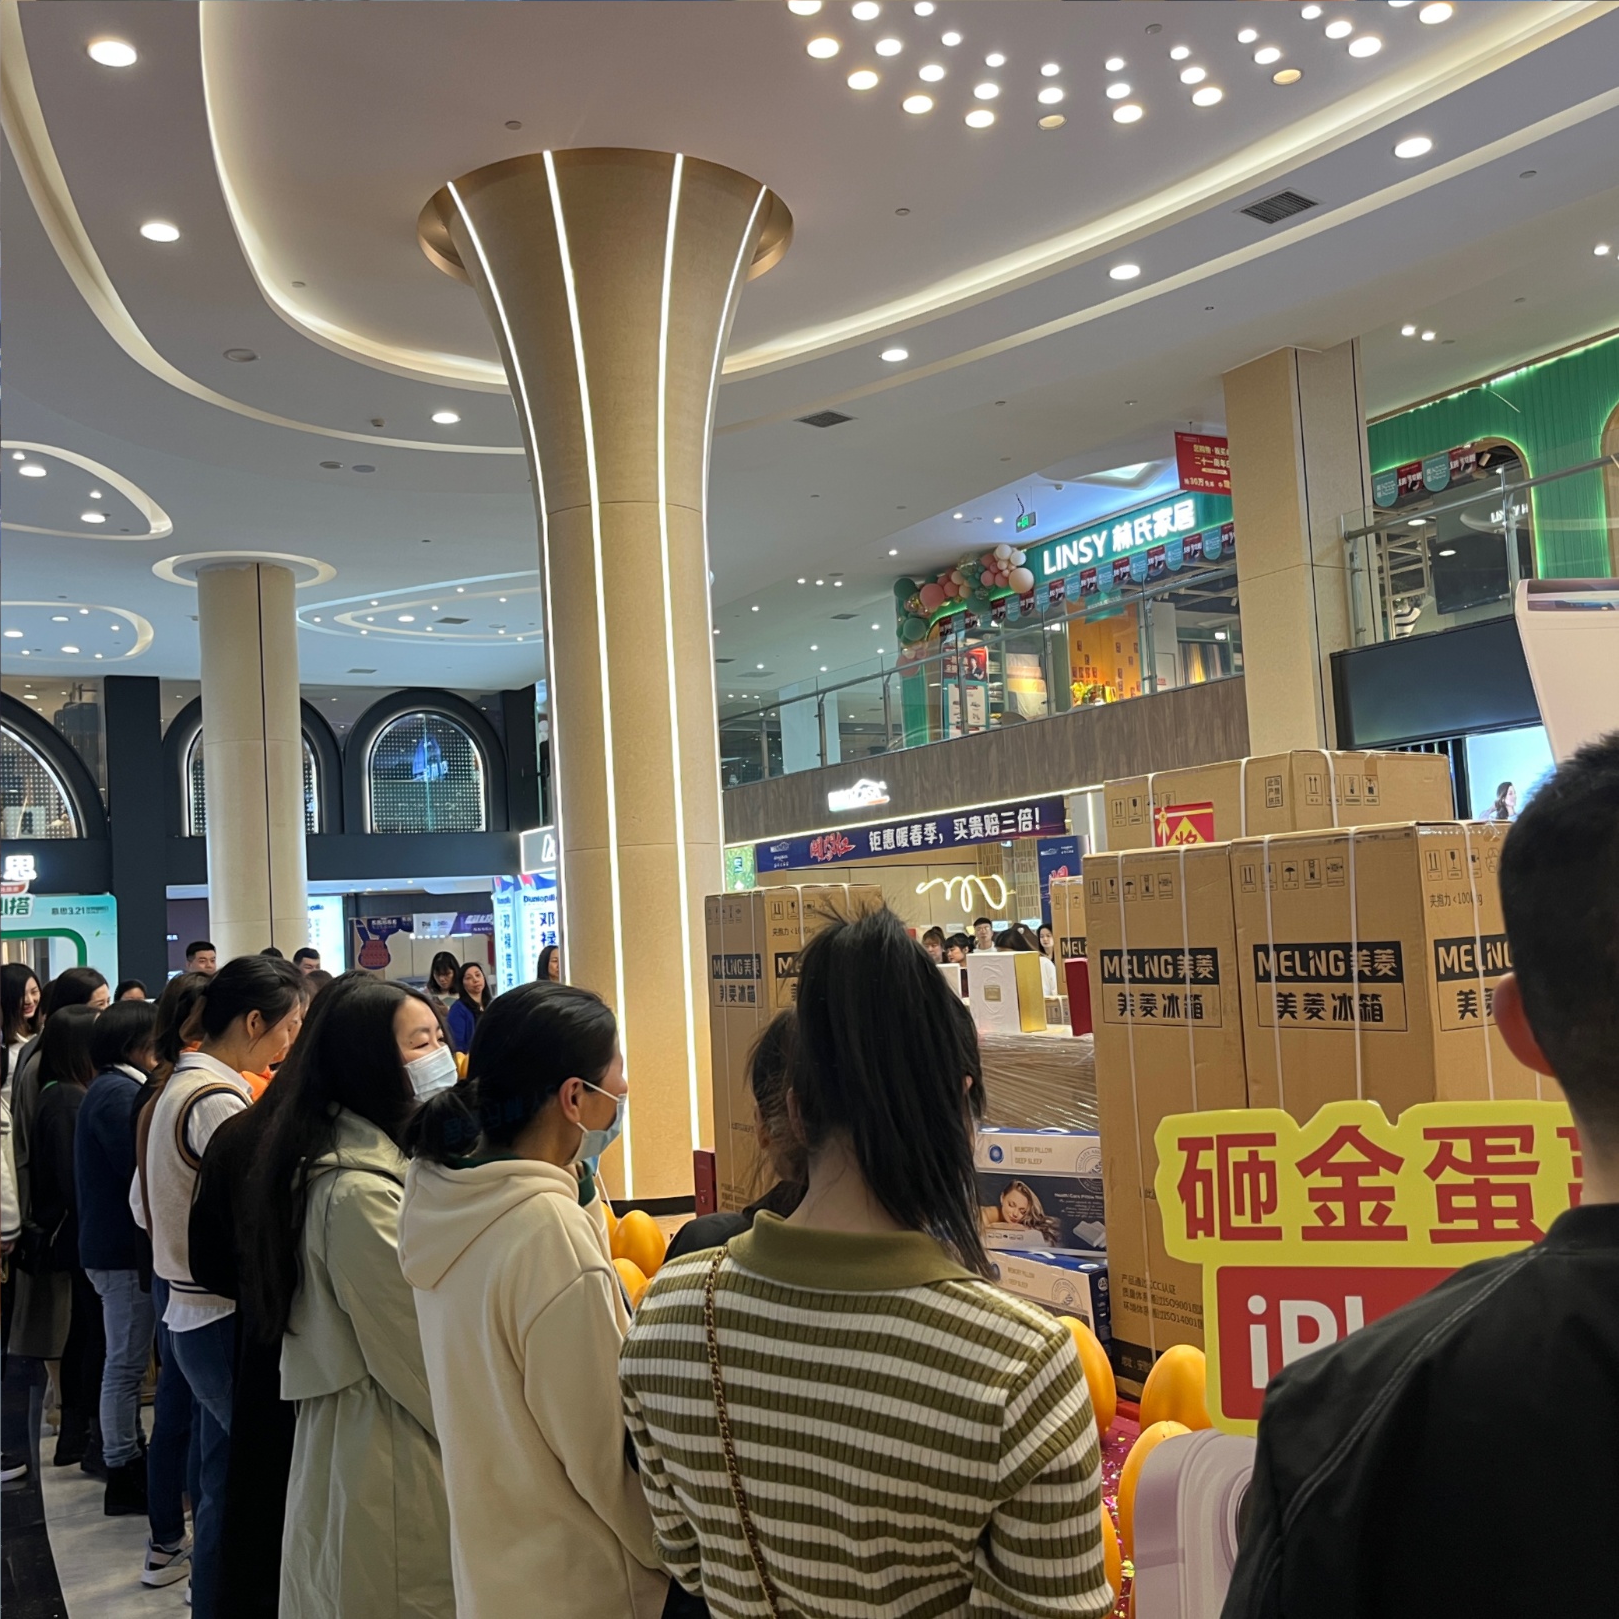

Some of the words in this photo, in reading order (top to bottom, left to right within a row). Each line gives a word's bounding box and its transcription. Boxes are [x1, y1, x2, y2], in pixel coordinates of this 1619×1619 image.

[1043, 530, 1108, 576] LINSY
[1112, 499, 1196, 552] 林氏家居
[1116, 991, 1204, 1021] 美菱冰箱
[1276, 991, 1384, 1024] 美菱冰箱
[1176, 1124, 1583, 1245] 砸金蛋
